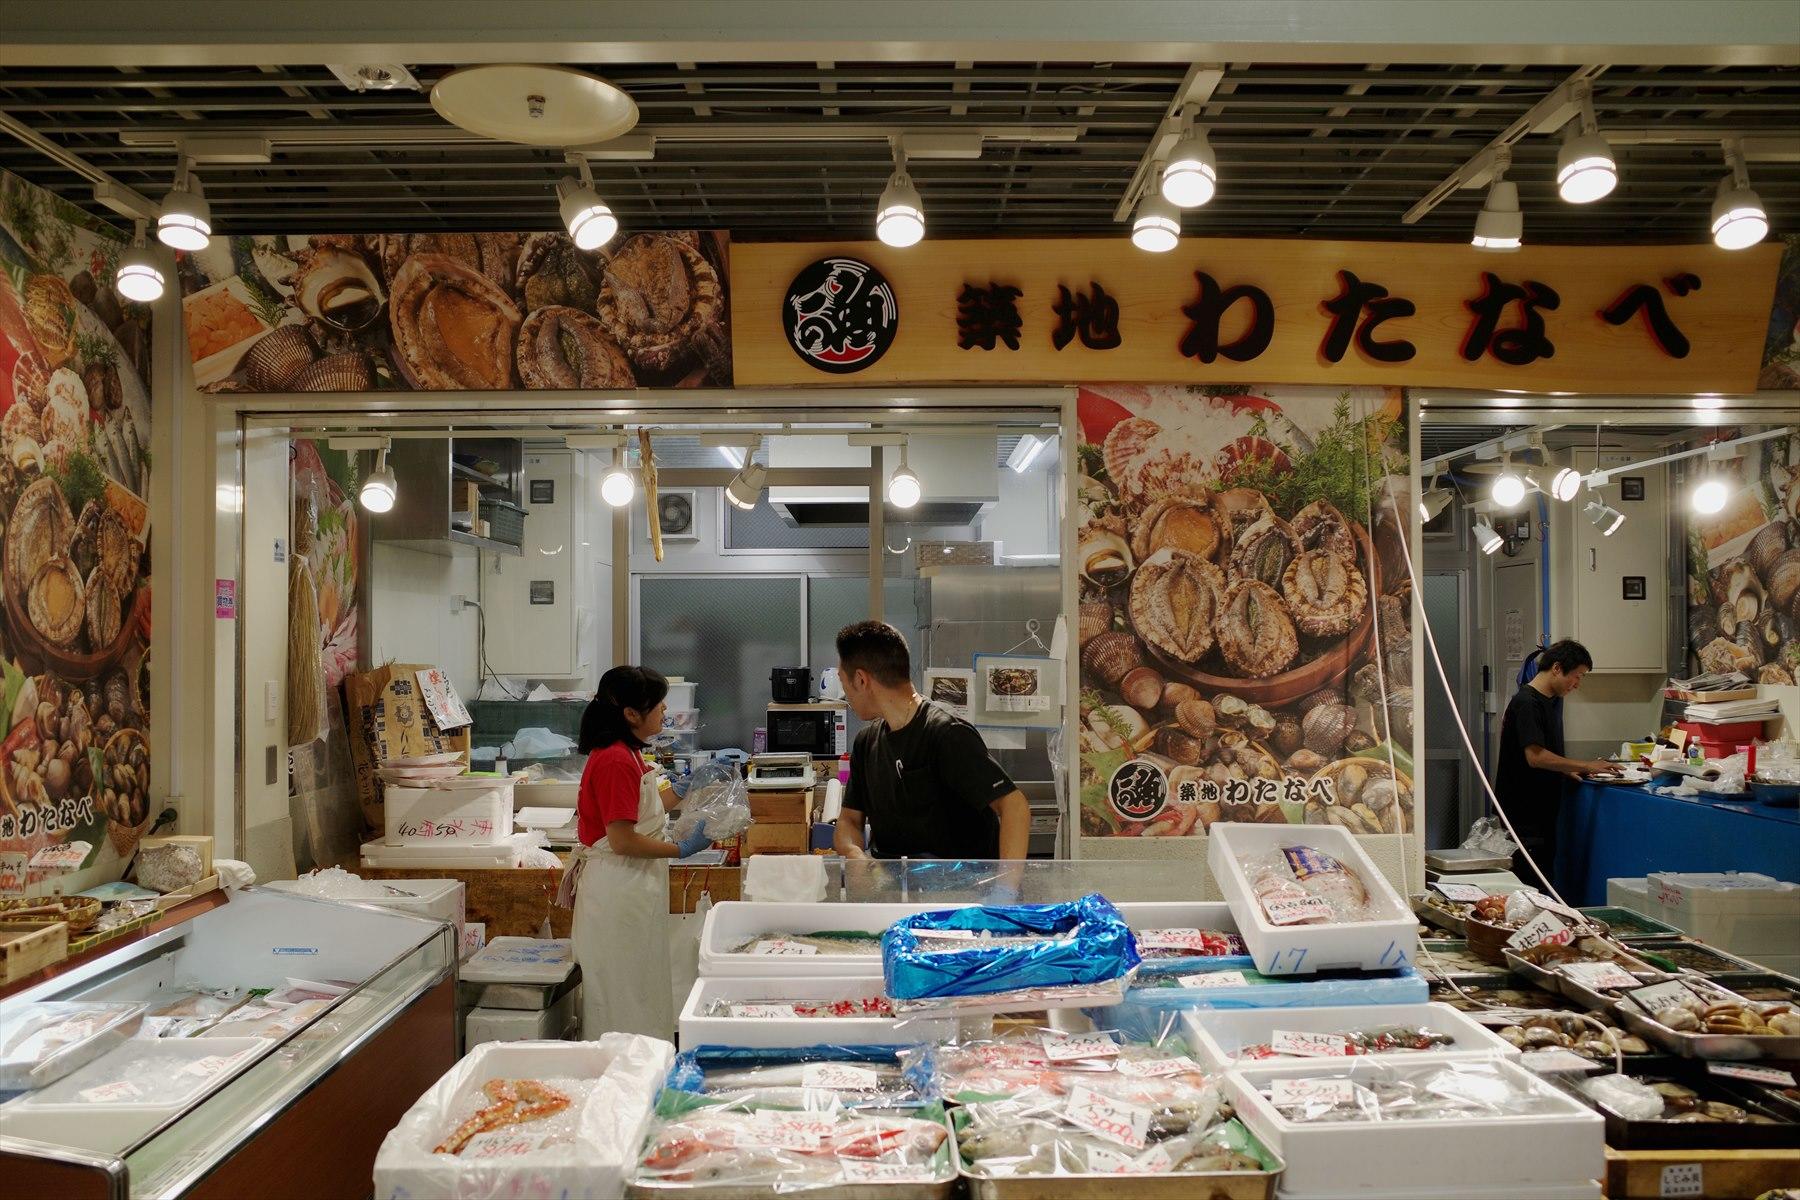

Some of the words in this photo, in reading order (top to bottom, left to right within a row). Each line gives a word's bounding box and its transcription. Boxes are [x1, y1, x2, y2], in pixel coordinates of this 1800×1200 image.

[957, 270, 1700, 365] 築地わたなべ
[1178, 777, 1335, 804] 築地わたなべ
